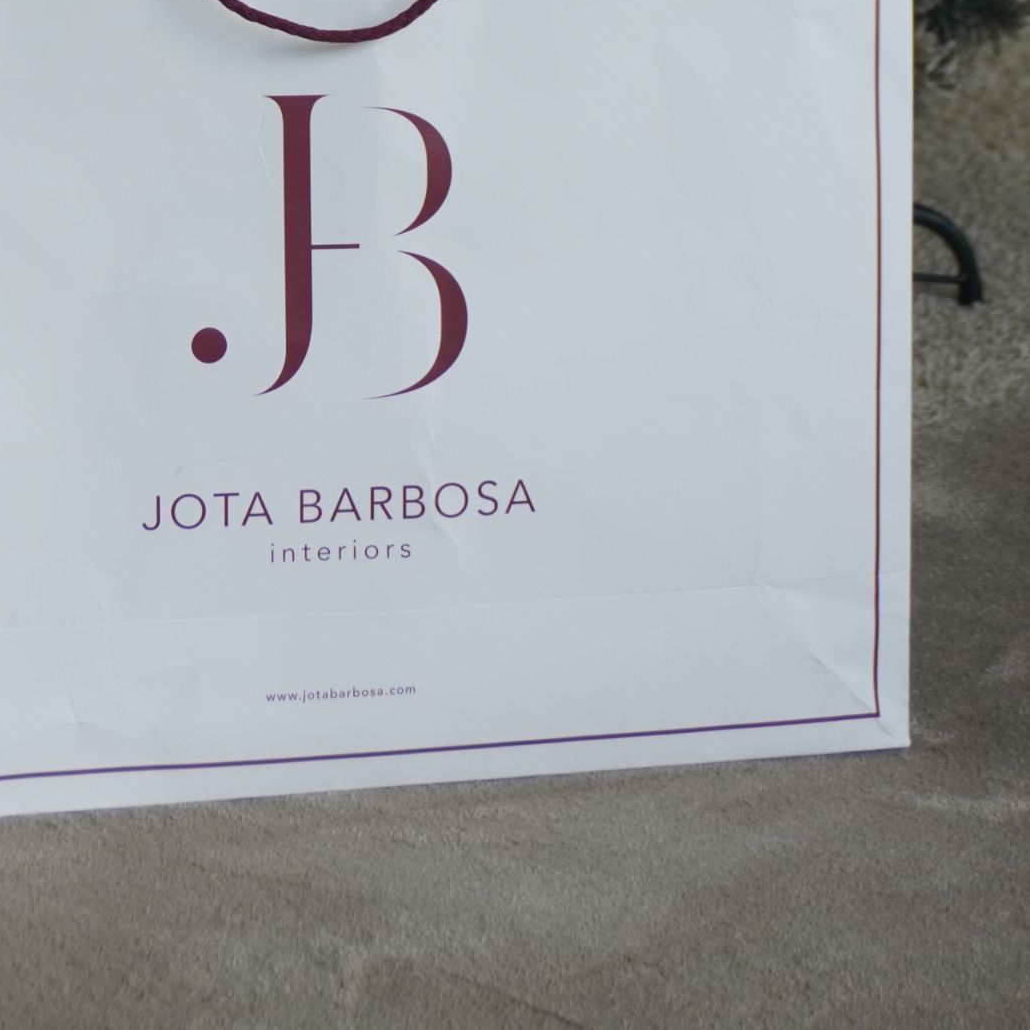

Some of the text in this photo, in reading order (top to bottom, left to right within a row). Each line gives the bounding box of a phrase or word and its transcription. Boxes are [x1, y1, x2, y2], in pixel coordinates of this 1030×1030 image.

[141, 478, 537, 532] JOTA BARBOSA
[270, 539, 412, 564] interiors
[265, 683, 417, 704] www.jotabarbosa.com
